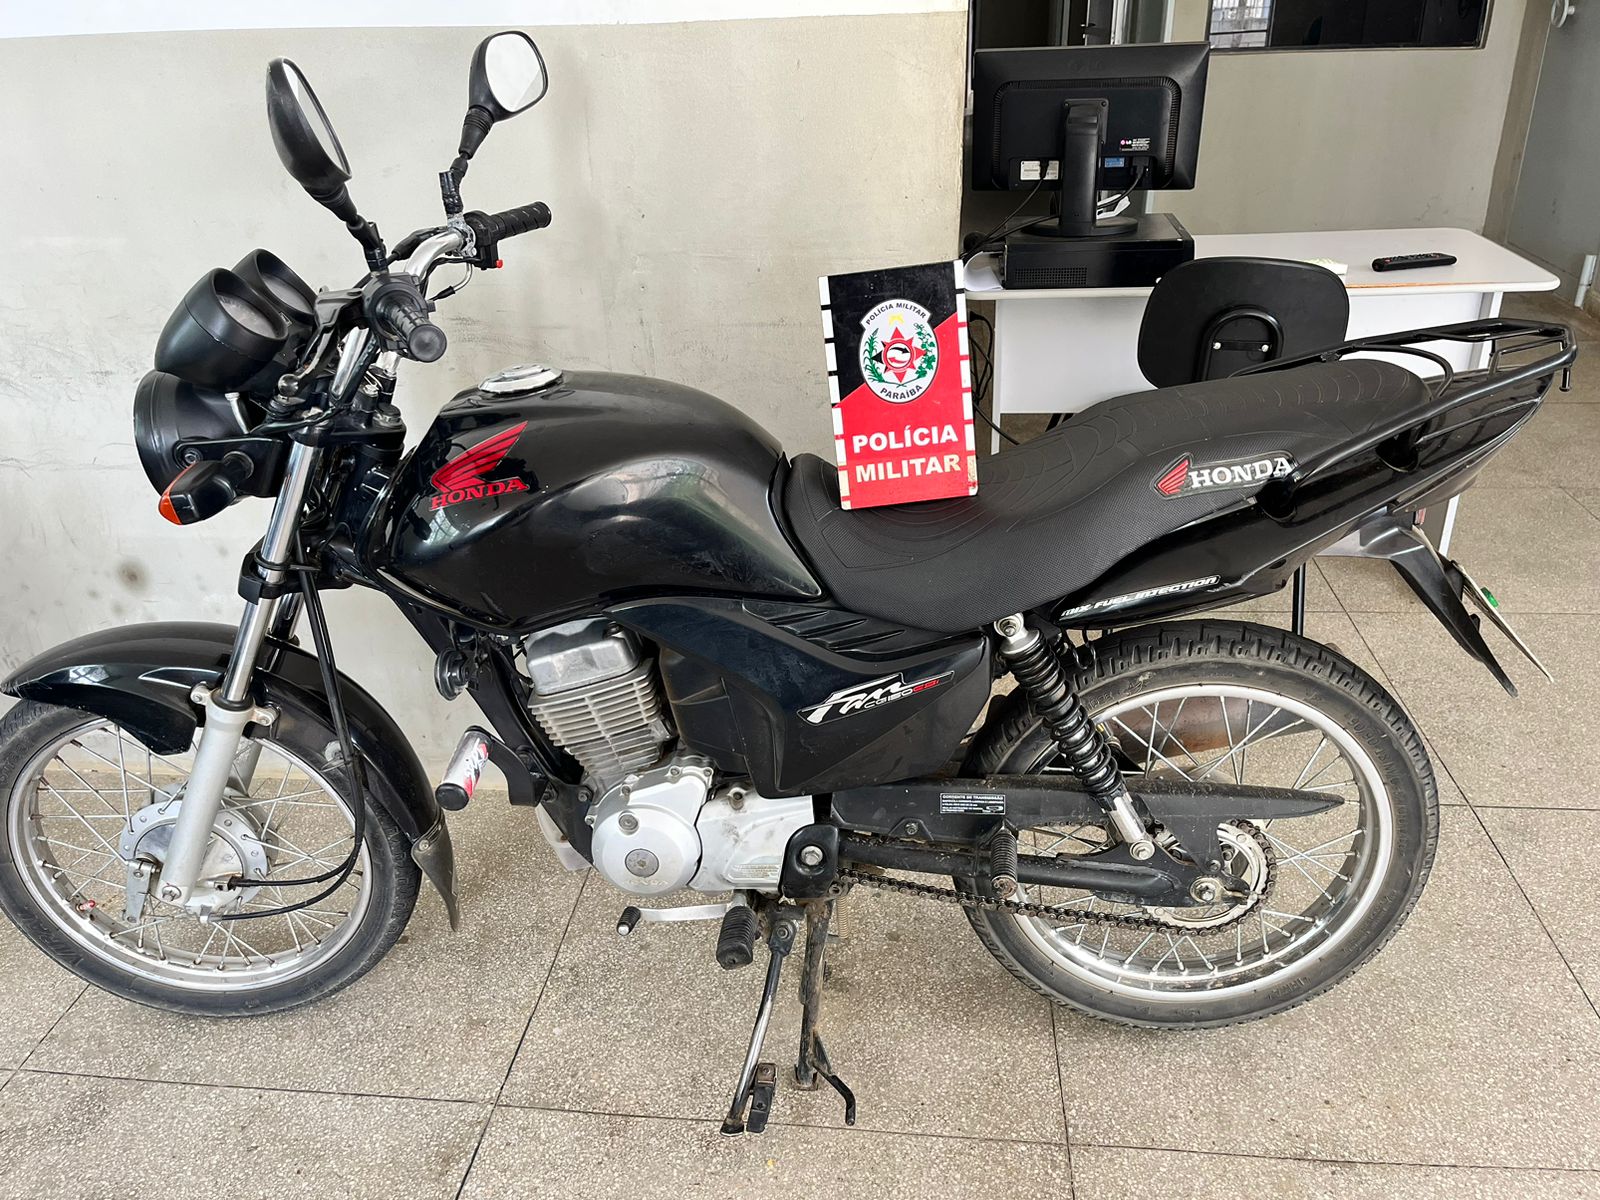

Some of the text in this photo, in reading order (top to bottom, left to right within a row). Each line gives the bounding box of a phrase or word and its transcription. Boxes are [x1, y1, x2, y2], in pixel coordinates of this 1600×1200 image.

[865, 302, 927, 325] POLÍCIA MILITAR
[880, 385, 922, 399] PARAÍBA
[852, 424, 958, 454] POLÍCIA
[855, 453, 961, 483] MILITAR
[1188, 456, 1293, 489] HONDA
[430, 479, 529, 510] HONDA
[1094, 594, 1130, 609] FUEL
[1130, 576, 1217, 600] INJECTION
